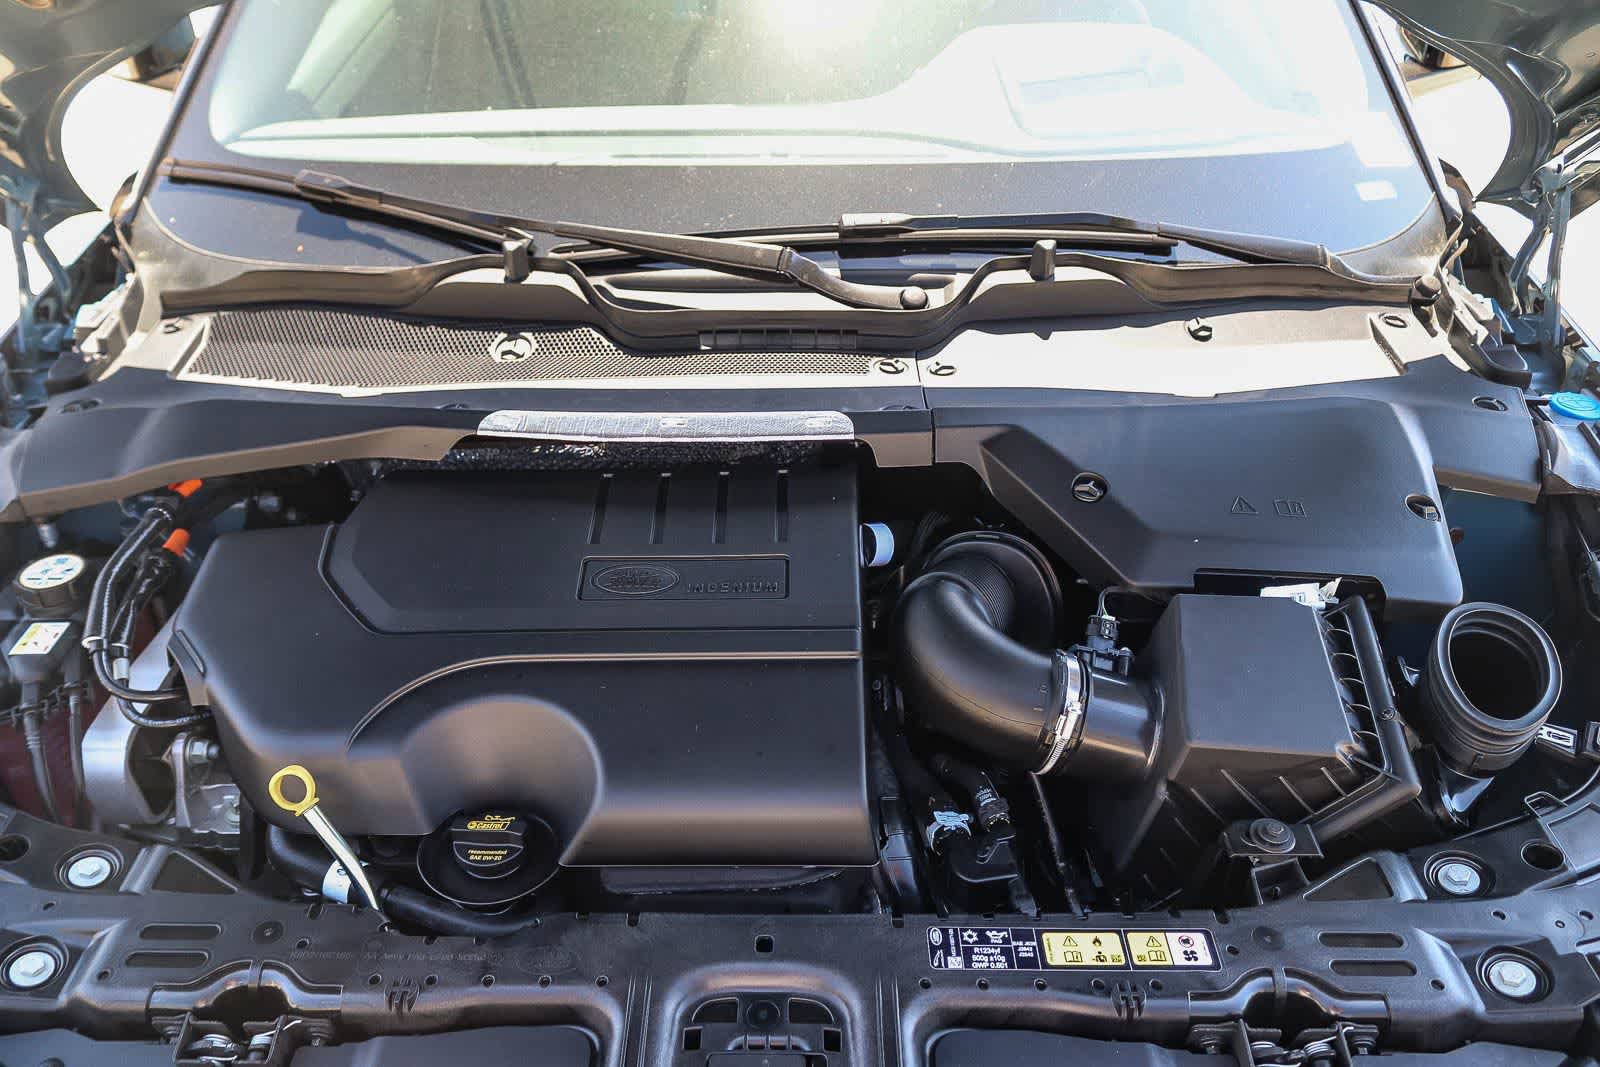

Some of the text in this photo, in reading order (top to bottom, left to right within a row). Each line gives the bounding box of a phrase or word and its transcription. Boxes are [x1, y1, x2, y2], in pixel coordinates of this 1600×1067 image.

[686, 580, 780, 593] INGENIUM
[477, 822, 503, 830] Castrol
[973, 947, 1001, 956] R1234yf
[971, 954, 989, 962] 500g
[971, 961, 989, 969] GWP
